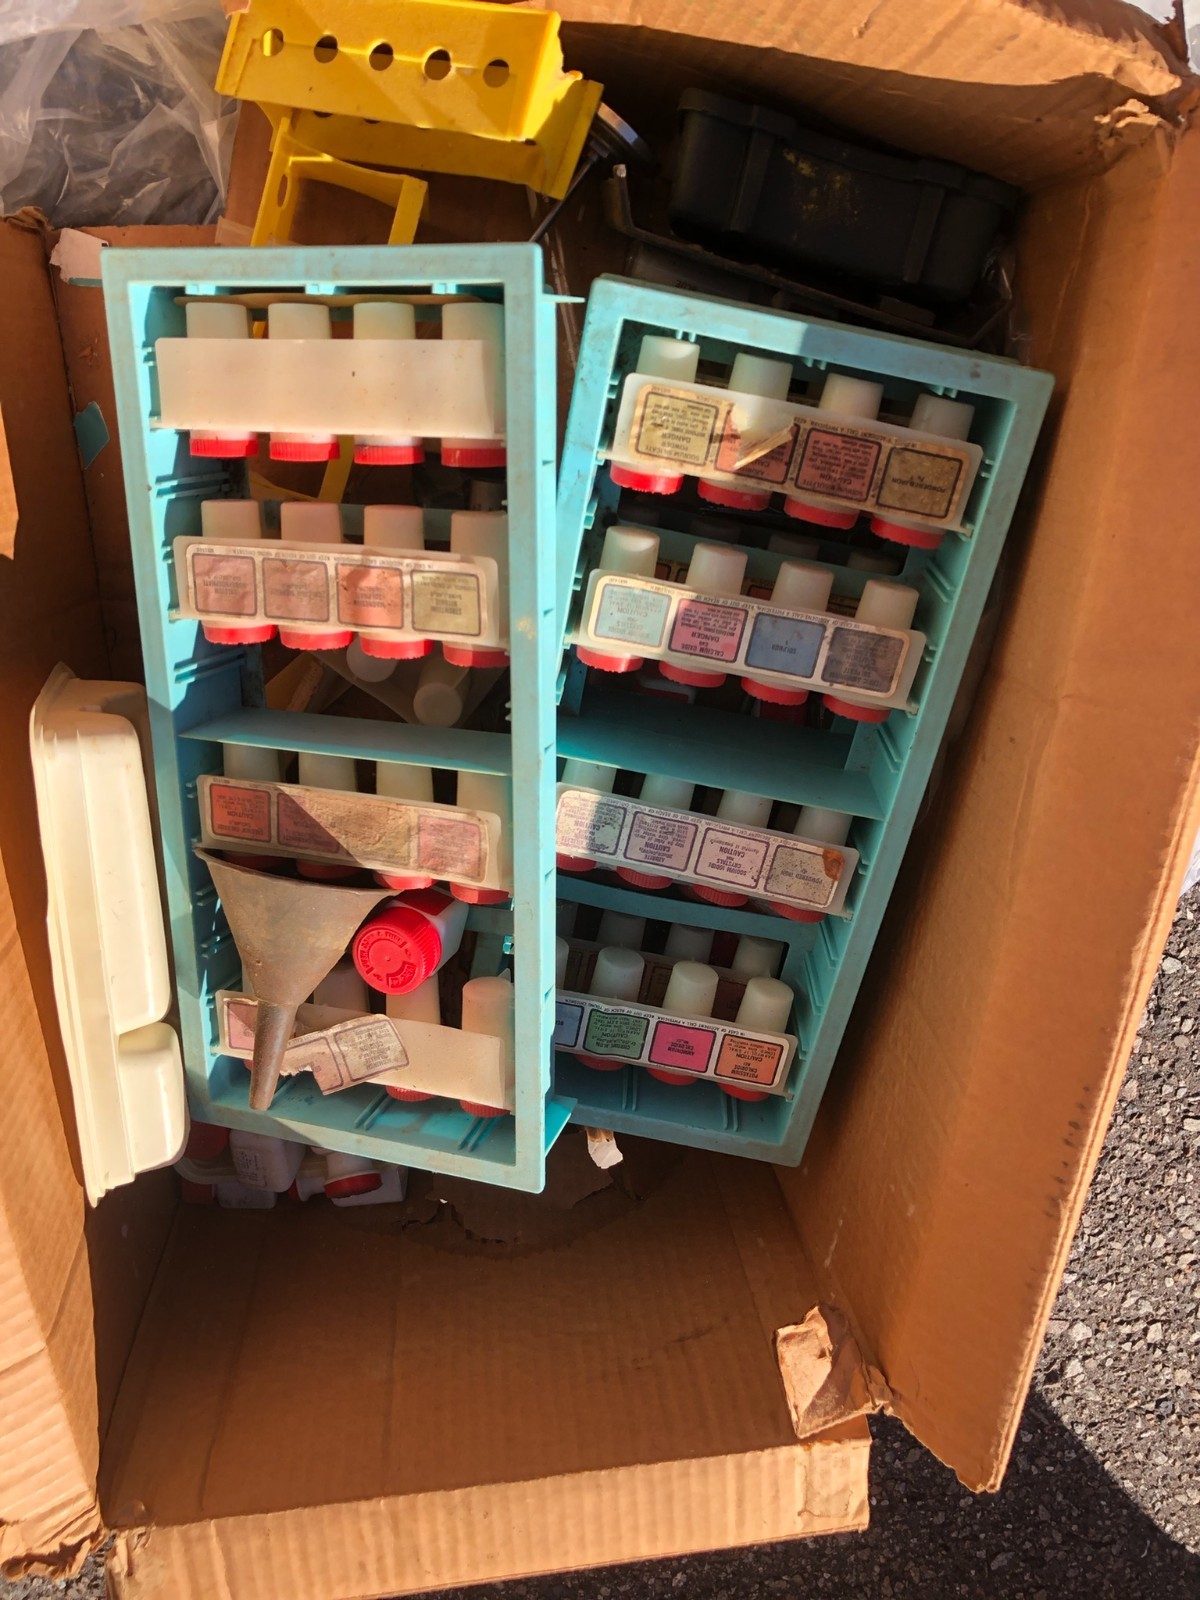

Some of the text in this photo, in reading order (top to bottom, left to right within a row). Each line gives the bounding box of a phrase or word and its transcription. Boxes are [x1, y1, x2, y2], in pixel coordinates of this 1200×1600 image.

[661, 431, 691, 443] DANGER
[617, 606, 648, 618] CAUTION
[690, 631, 719, 642] DANGER
[679, 642, 724, 657] CALCIUM OXIDE
[226, 809, 254, 818] CAUTION
[573, 819, 600, 830] CAUTION
[644, 841, 670, 852] CAUTION
[718, 845, 745, 857] CAUTION
[643, 853, 665, 862] AZURITE
[715, 857, 741, 868] CRYSTALS
[707, 861, 746, 875] SODIUM IODIDE
[795, 873, 822, 884] POWDERED
[698, 1023, 719, 1031] ACCIDENT
[667, 1046, 695, 1055] AMMONIUM
[670, 1041, 694, 1050] CHLORIDE
[735, 1052, 762, 1062] CAUTION
[730, 1068, 758, 1078] POTASSIUM
[733, 1063, 757, 1072] CHLORIDE
